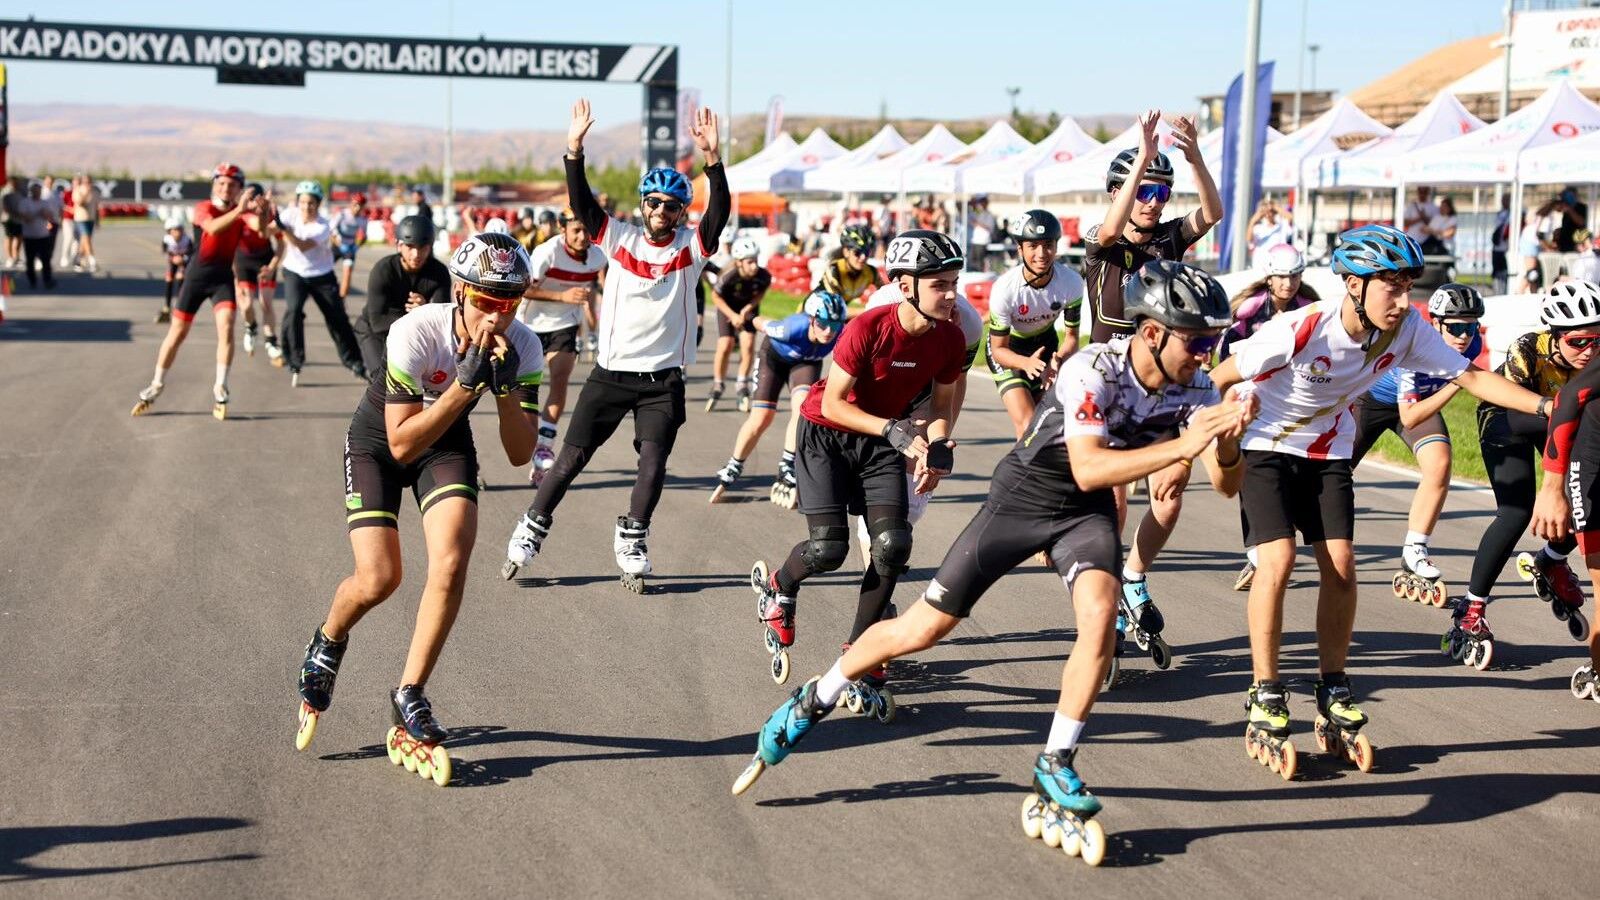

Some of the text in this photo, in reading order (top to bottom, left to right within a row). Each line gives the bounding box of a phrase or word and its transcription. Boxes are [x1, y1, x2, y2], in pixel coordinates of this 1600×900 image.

[1, 26, 190, 63] KAPADOKYA
[196, 35, 302, 67] MOTOR
[307, 41, 441, 72] SPORLARI
[889, 241, 913, 263] 32
[1300, 373, 1332, 384] VIGOR
